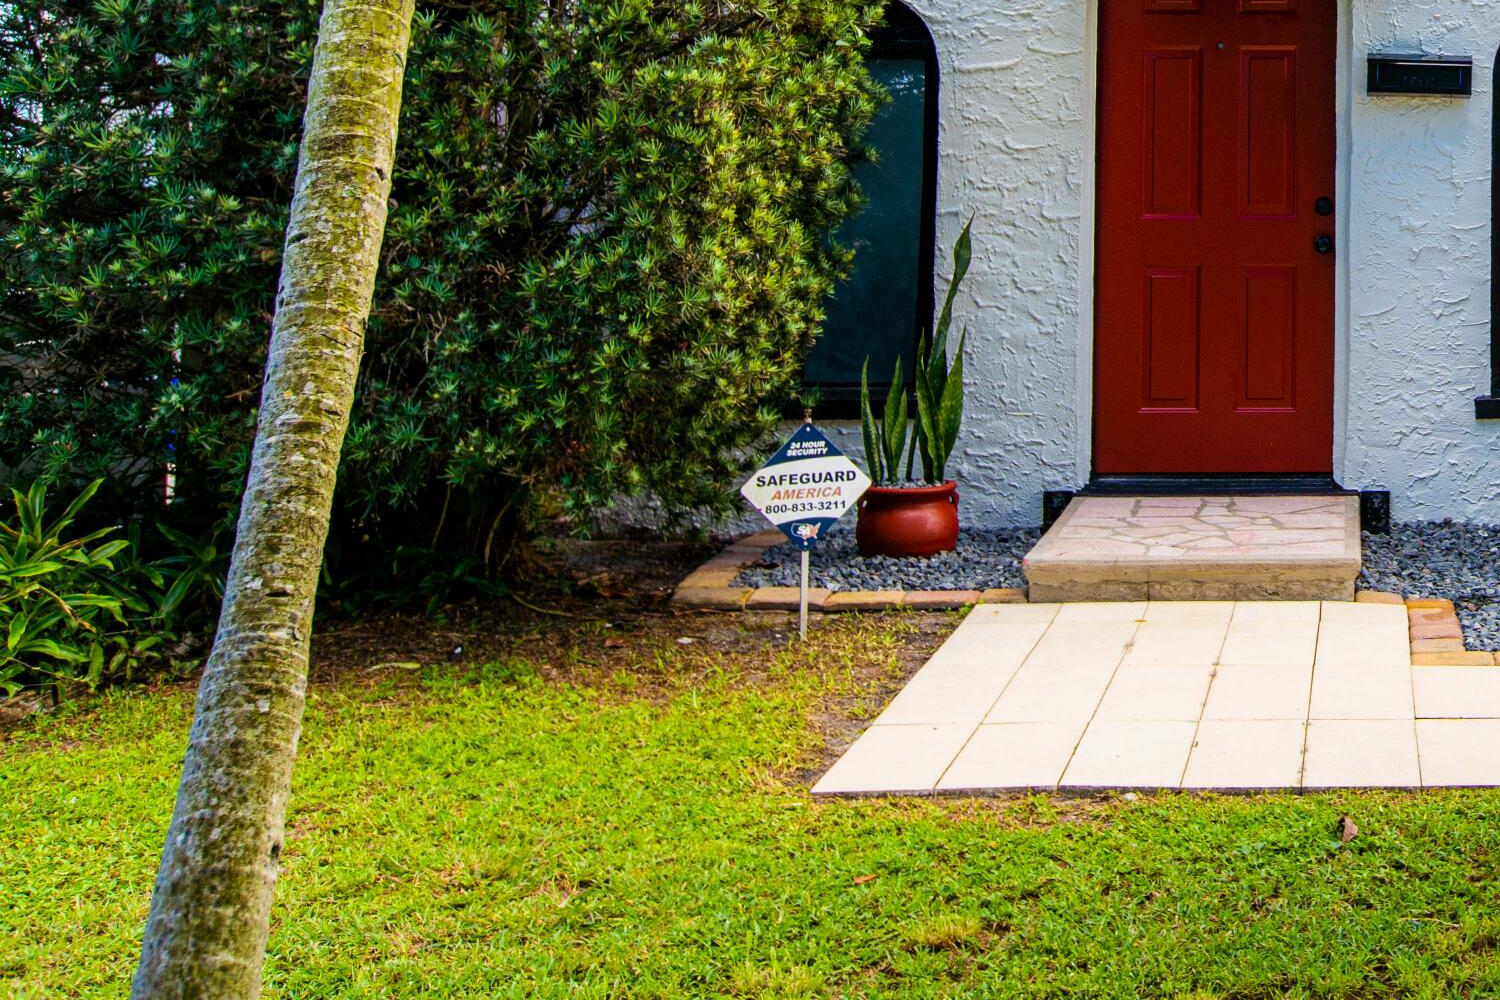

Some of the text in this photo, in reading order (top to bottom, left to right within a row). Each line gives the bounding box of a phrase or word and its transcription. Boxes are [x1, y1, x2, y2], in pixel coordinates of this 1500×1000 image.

[786, 448, 828, 456] SECURITY
[756, 470, 856, 487] SAFEGUARD
[772, 487, 842, 501] AMERICA
[765, 501, 846, 513] 800-833-3211
